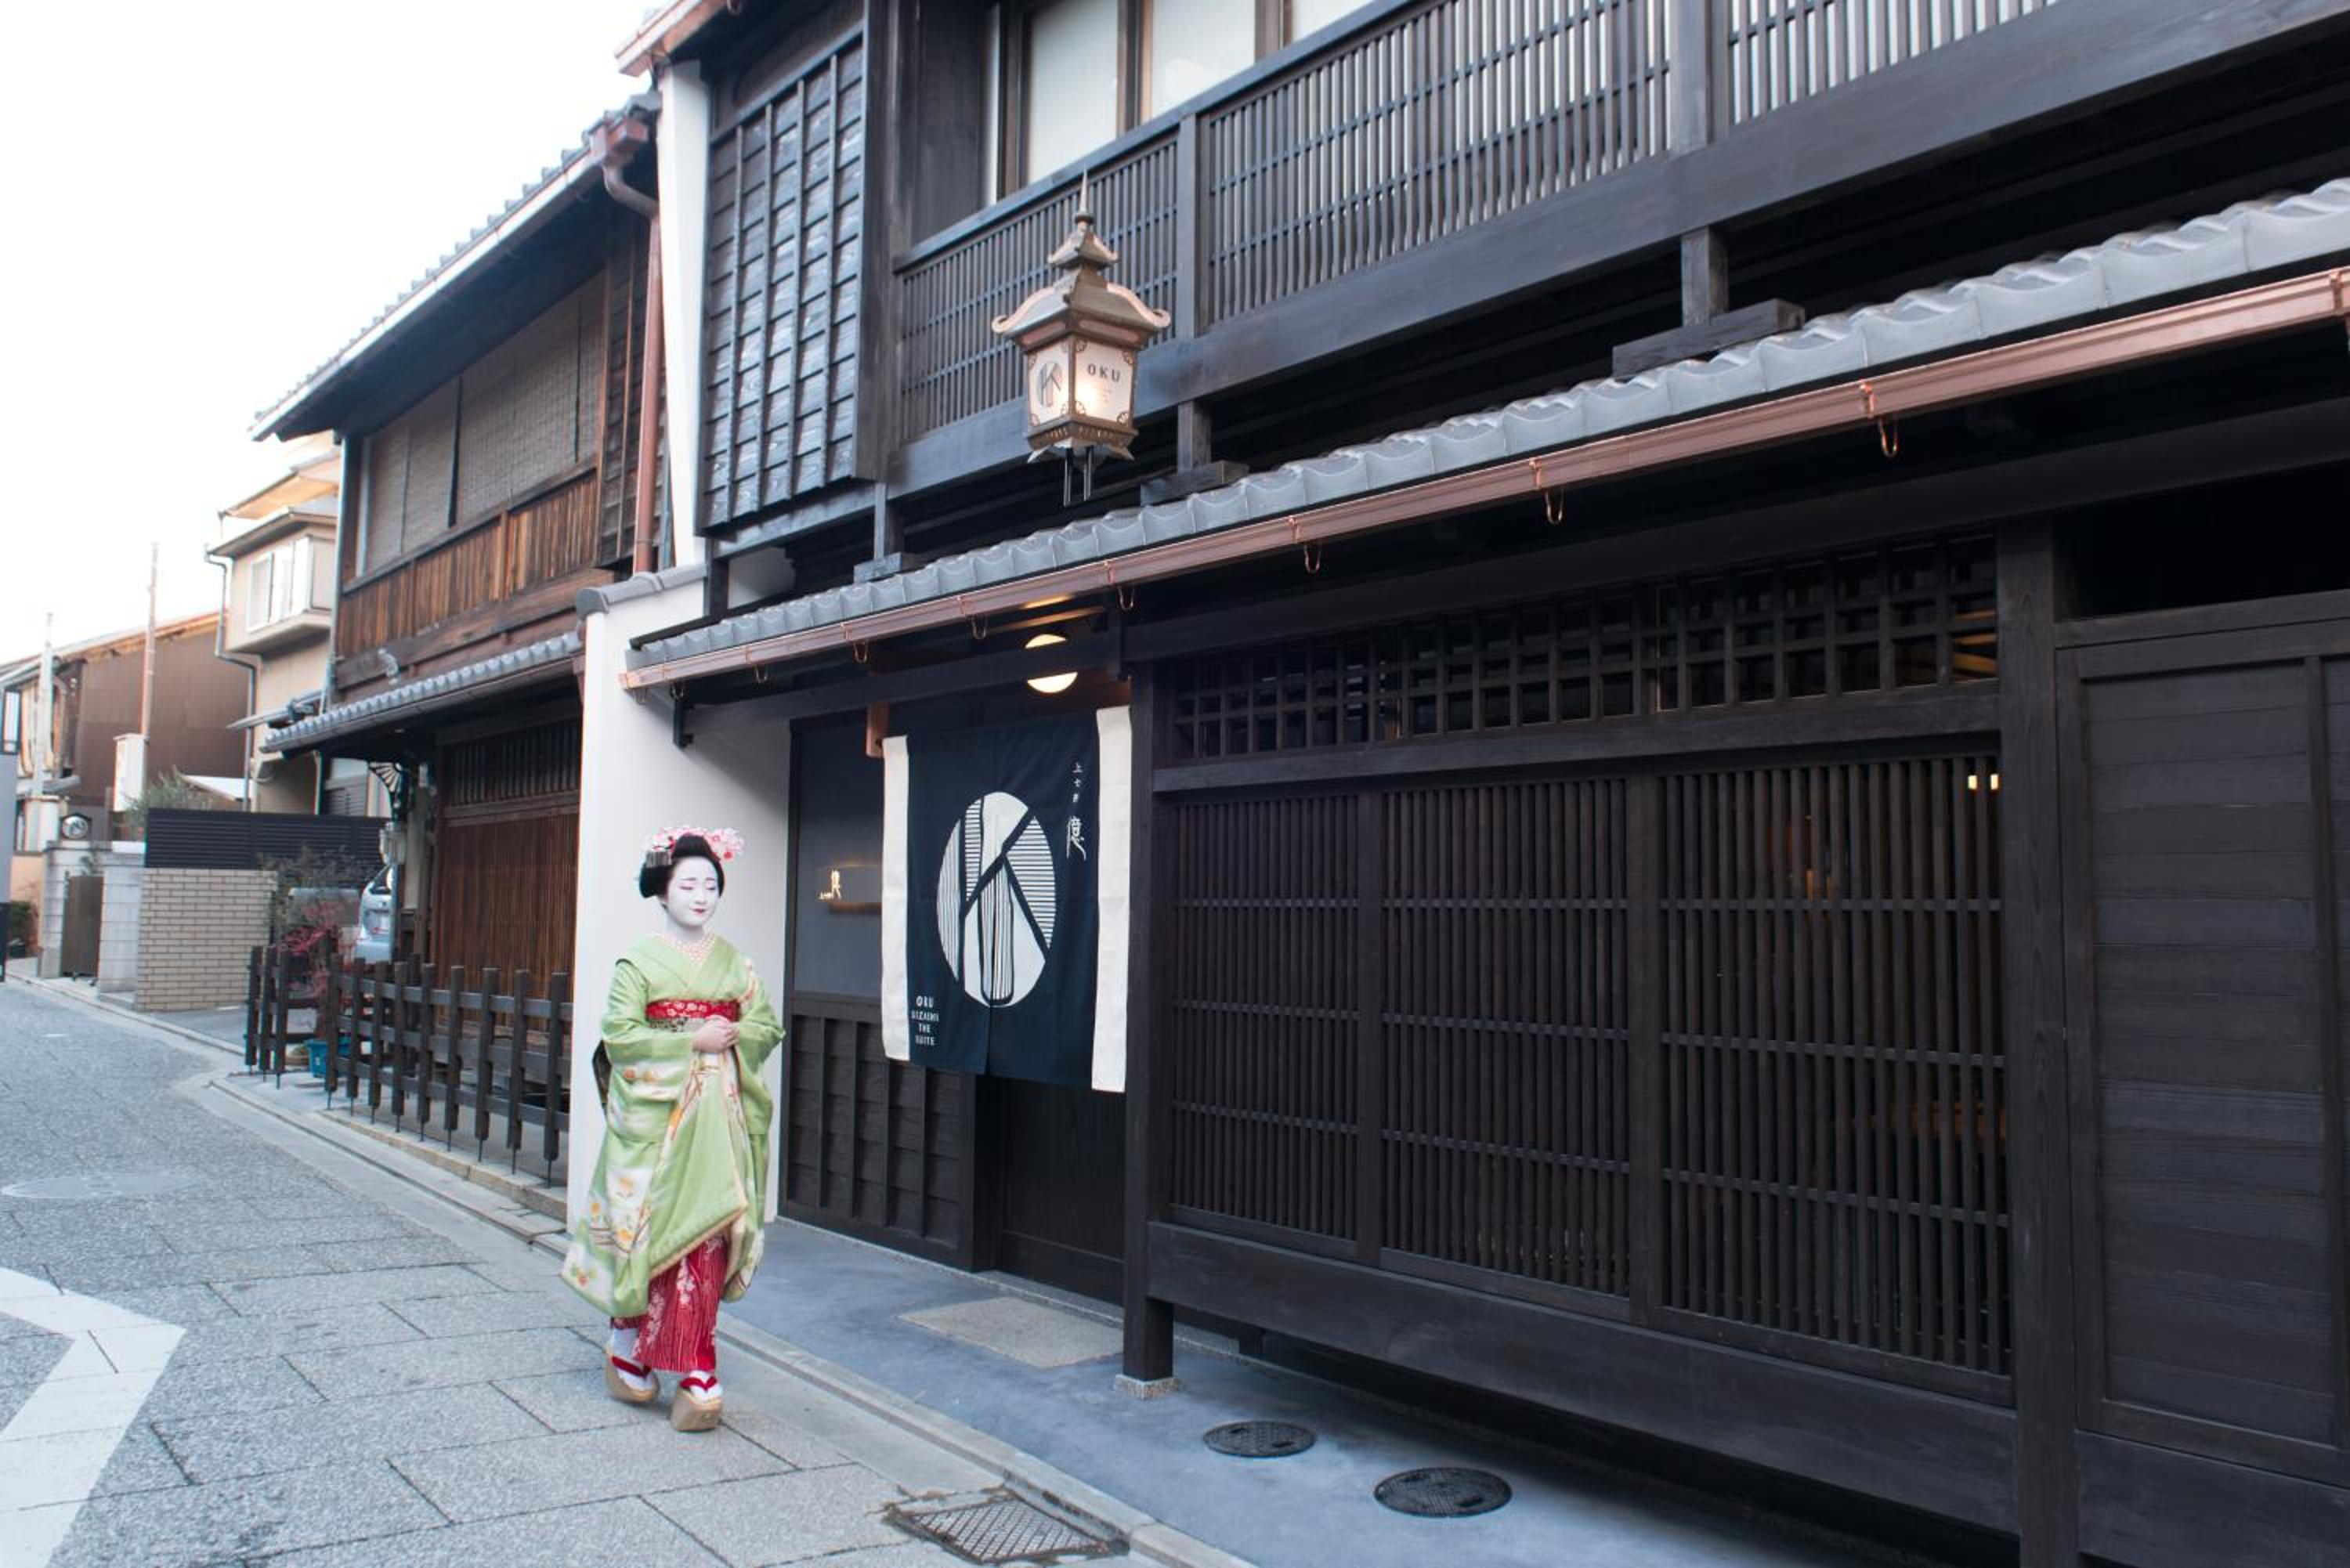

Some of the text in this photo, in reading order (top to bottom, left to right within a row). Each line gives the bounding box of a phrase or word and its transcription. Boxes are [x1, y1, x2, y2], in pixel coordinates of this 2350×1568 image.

[1087, 363, 1120, 382] OKU
[916, 995, 934, 1008] OKU
[919, 1023, 931, 1033] THE
